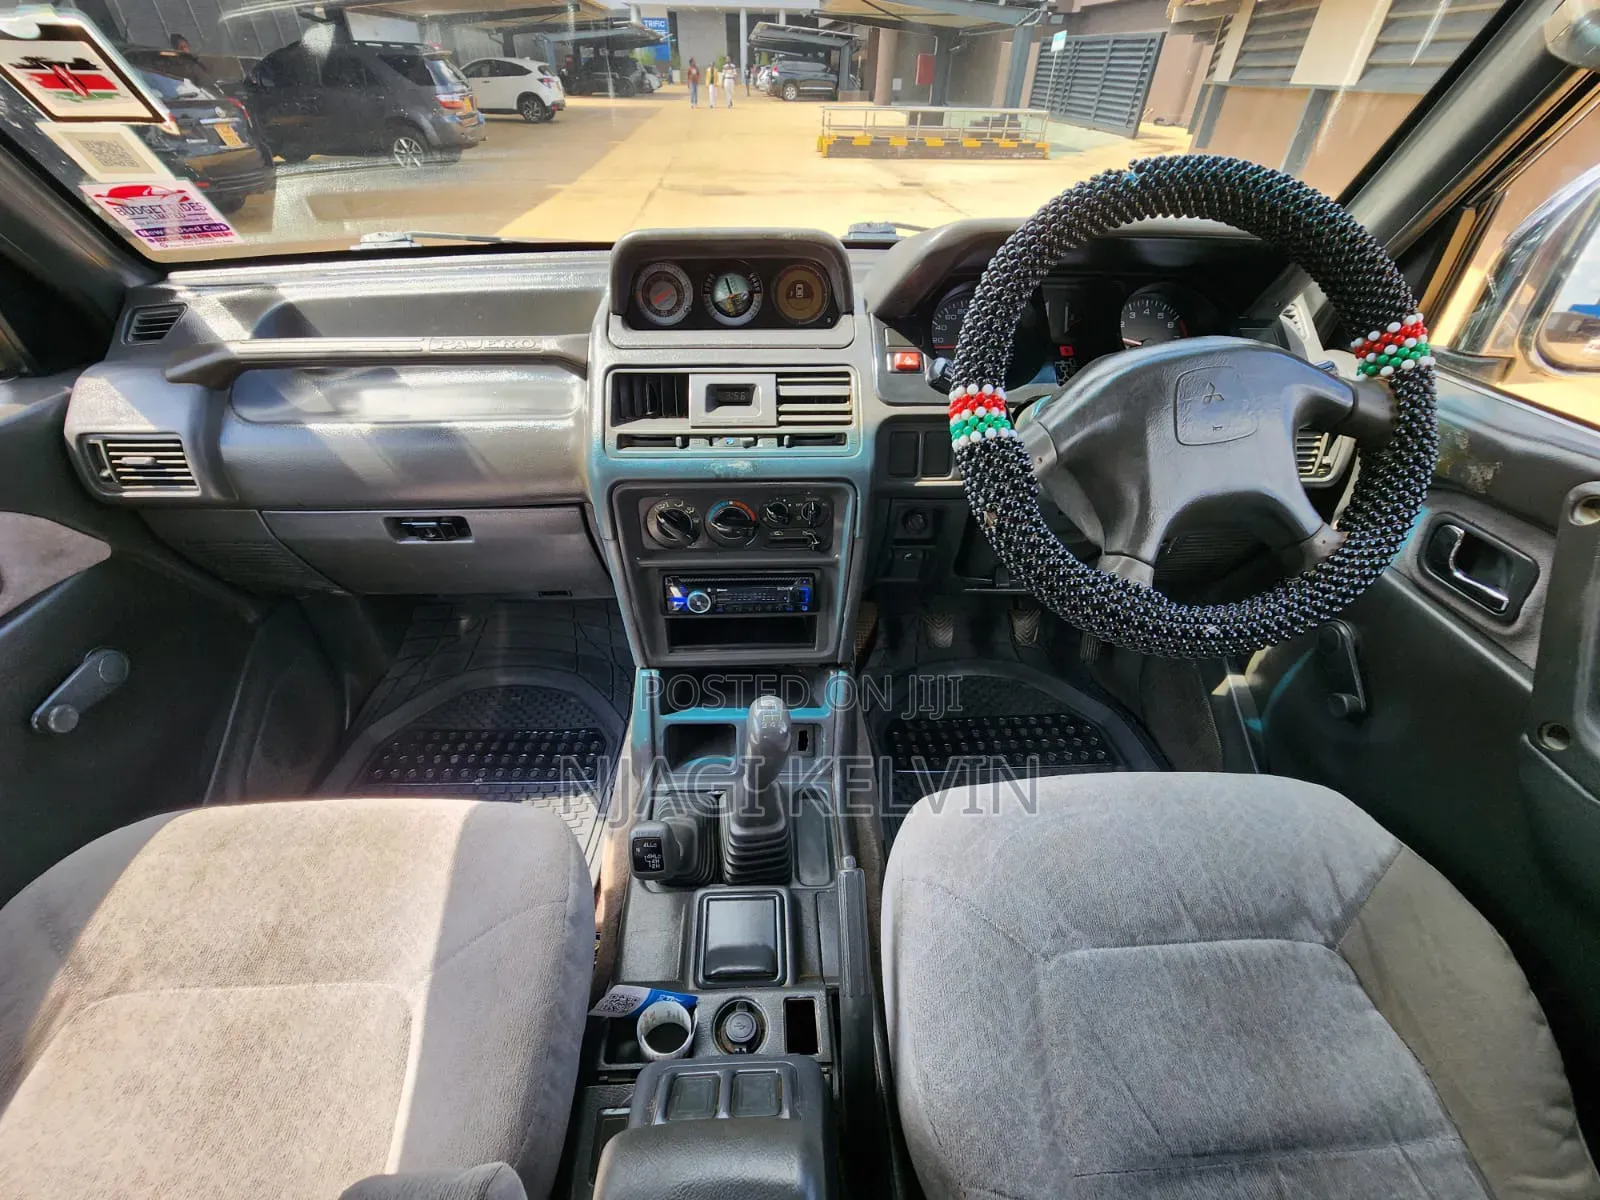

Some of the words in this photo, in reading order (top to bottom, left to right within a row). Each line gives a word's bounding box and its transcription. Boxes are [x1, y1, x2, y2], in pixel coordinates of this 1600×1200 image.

[113, 204, 166, 217] BUDGET
[203, 223, 229, 232] Cars
[1129, 311, 1136, 319] 3
[1143, 308, 1151, 316] 4
[438, 338, 537, 350] PAJERO
